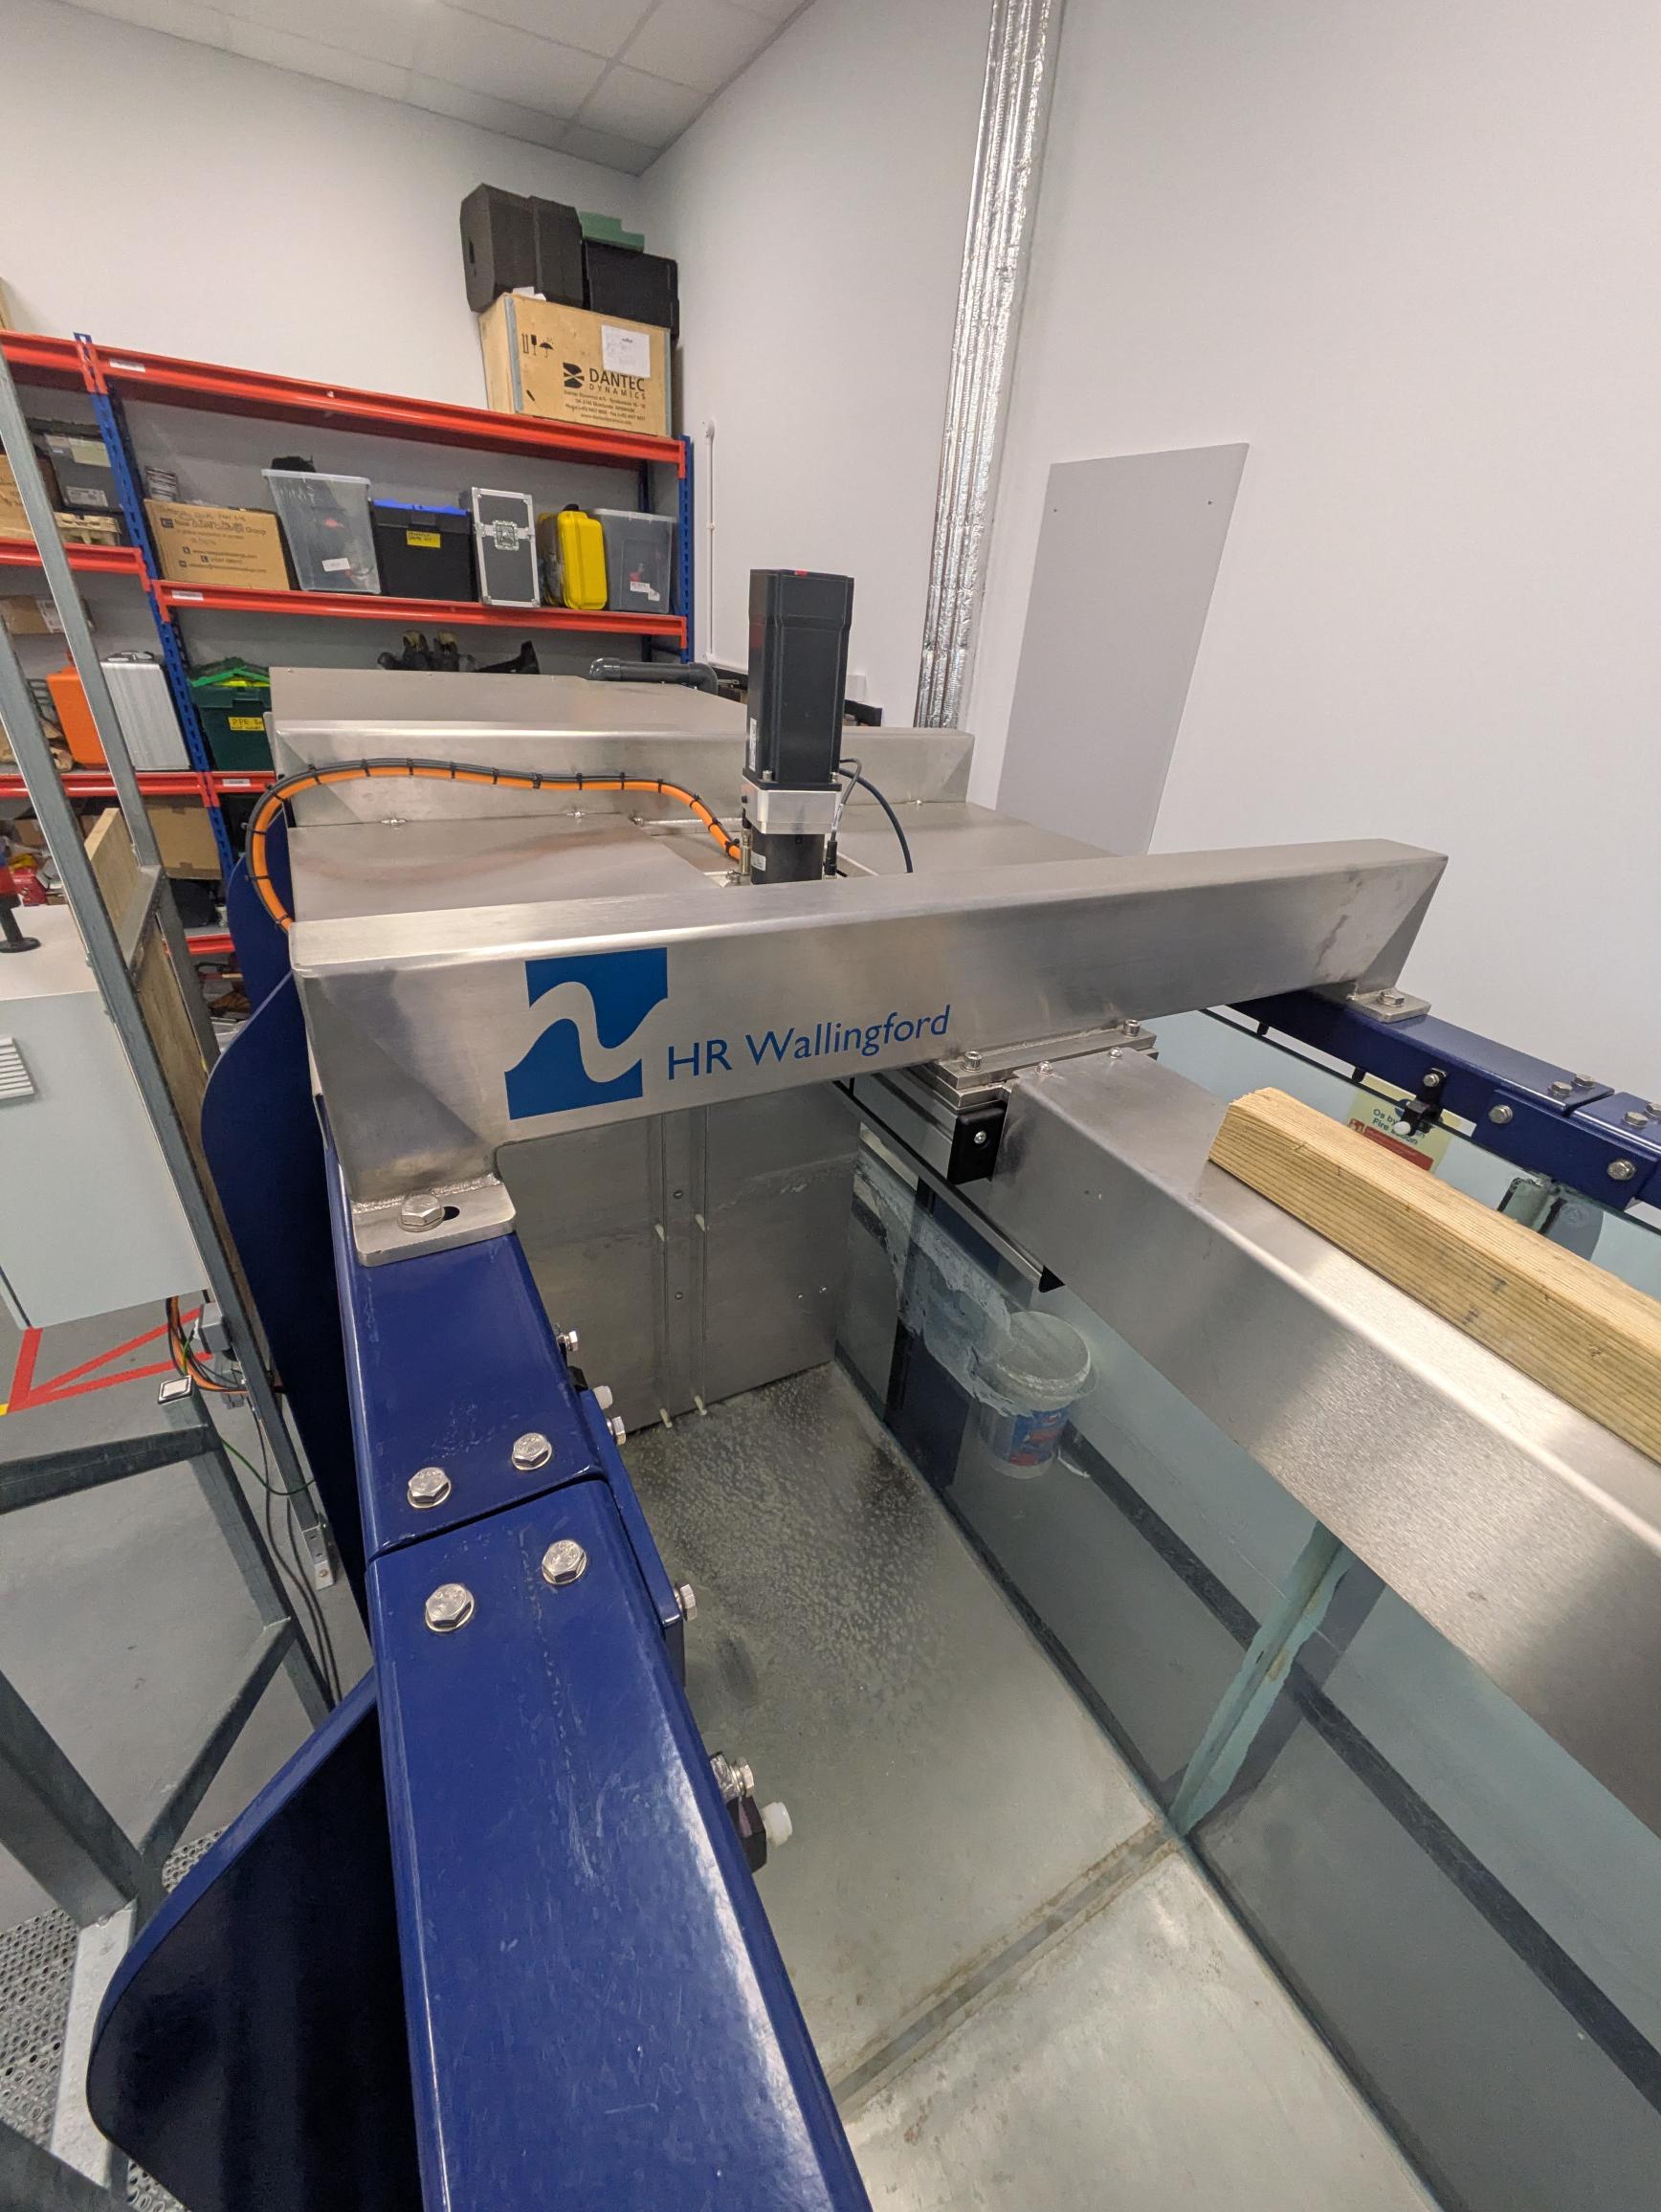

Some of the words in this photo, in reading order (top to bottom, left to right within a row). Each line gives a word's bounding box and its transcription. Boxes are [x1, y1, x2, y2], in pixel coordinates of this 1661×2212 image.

[589, 367, 646, 392] DANTEC
[589, 383, 647, 400] DYNAMICS
[668, 1039, 733, 1080] HR
[745, 1004, 951, 1068] Wallingford
[1372, 1117, 1389, 1131] Fire
